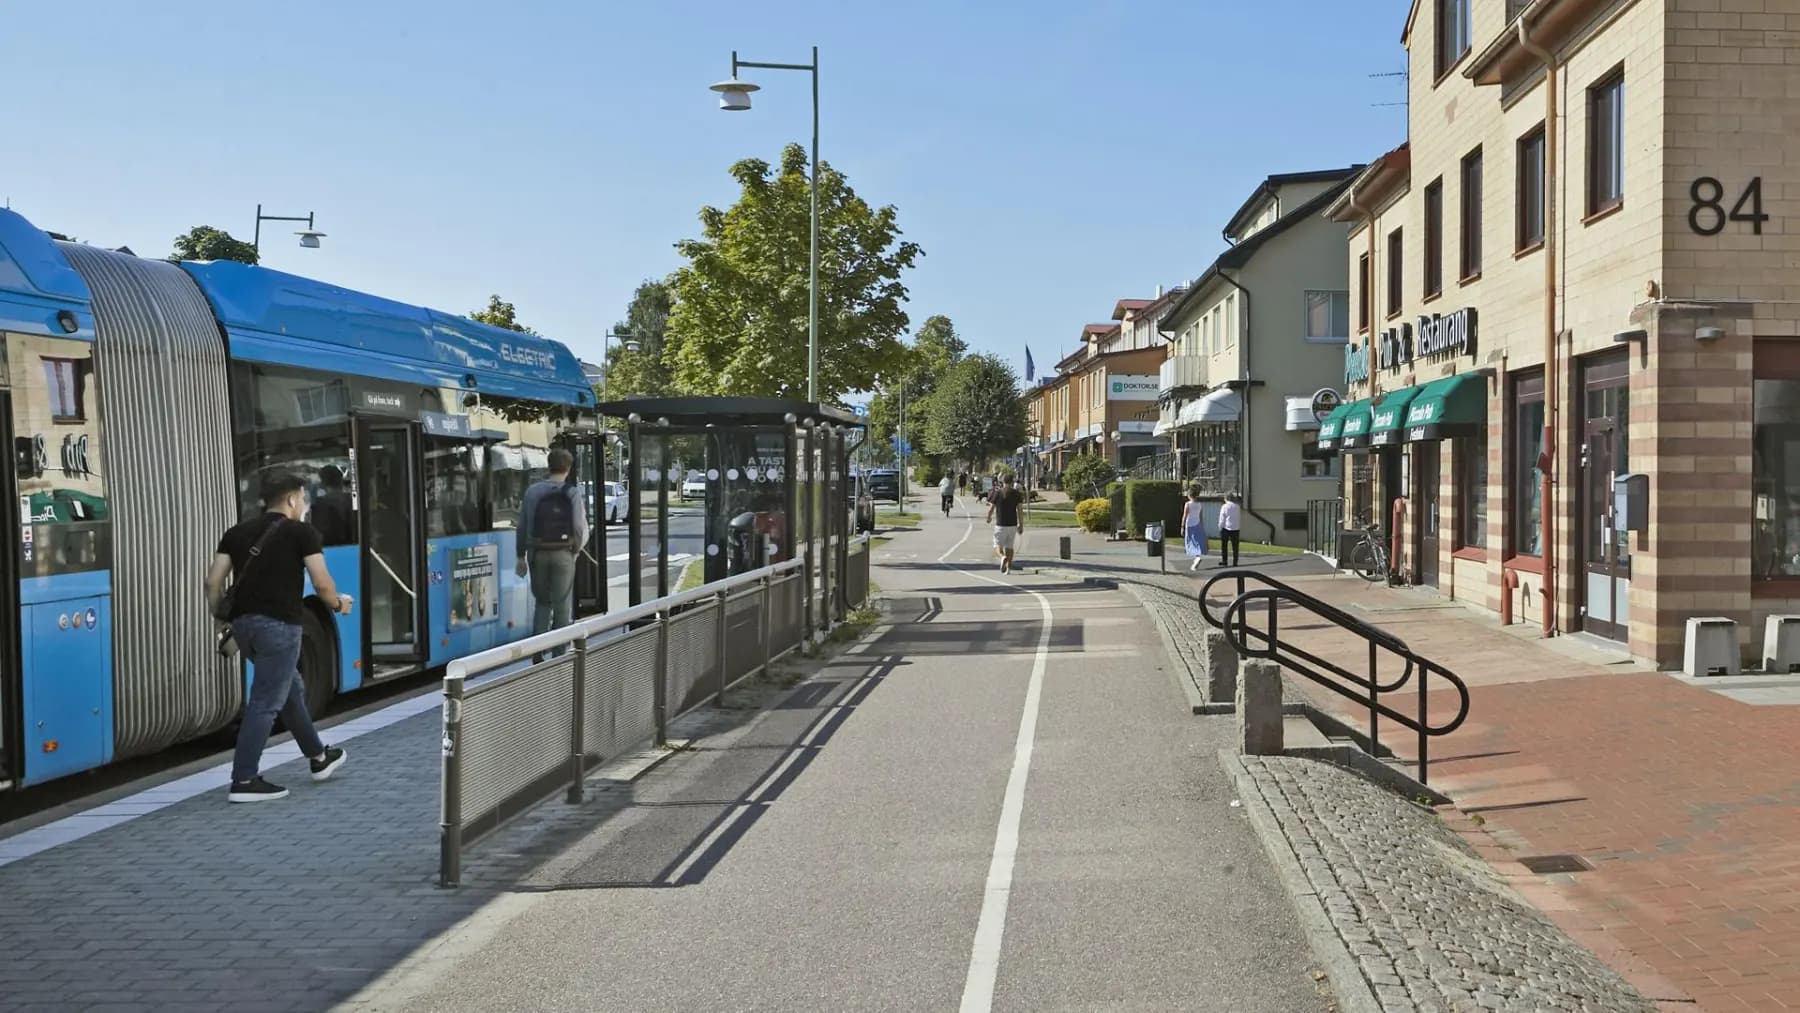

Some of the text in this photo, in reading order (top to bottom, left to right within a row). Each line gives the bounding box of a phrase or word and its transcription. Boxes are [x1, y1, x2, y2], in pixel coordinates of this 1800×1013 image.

[1688, 176, 1769, 236] 84
[1417, 309, 1467, 355] Restaurang
[501, 343, 556, 370] ELECTRIC
[747, 456, 757, 466] A
